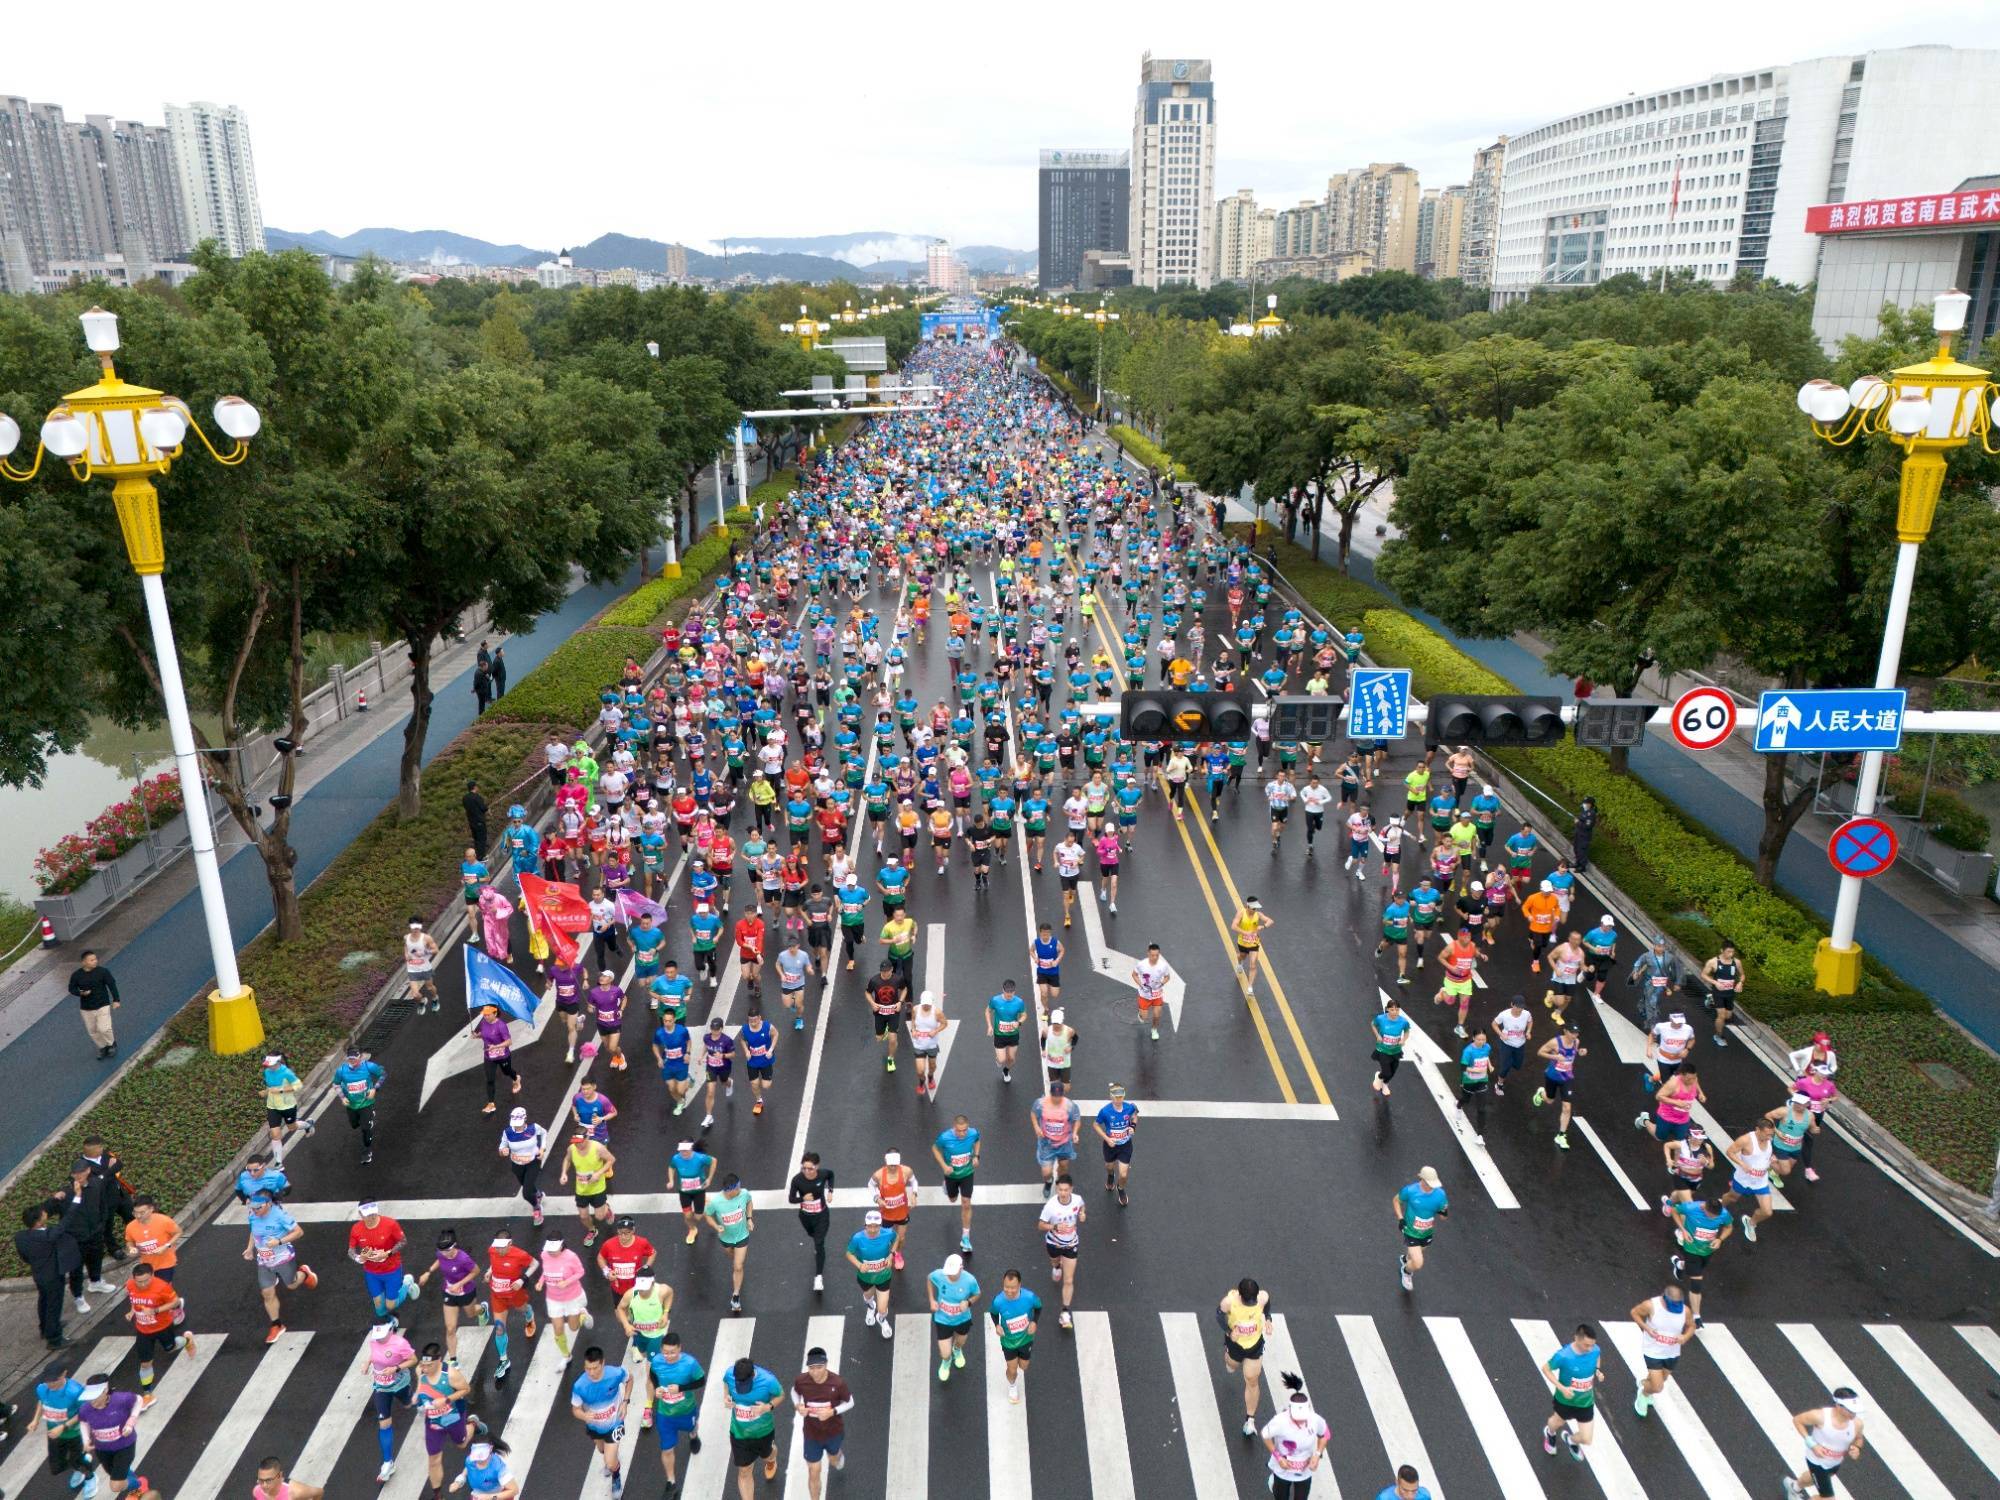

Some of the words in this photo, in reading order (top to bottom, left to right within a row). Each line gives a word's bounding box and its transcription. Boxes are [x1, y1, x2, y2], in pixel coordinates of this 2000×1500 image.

[1829, 194, 2000, 228] 热烈祝贺苍南县武术
[1682, 705, 1726, 732] 60
[1777, 705, 1789, 718] 西
[1805, 708, 1898, 732] 人民大道
[1775, 726, 1785, 735] W
